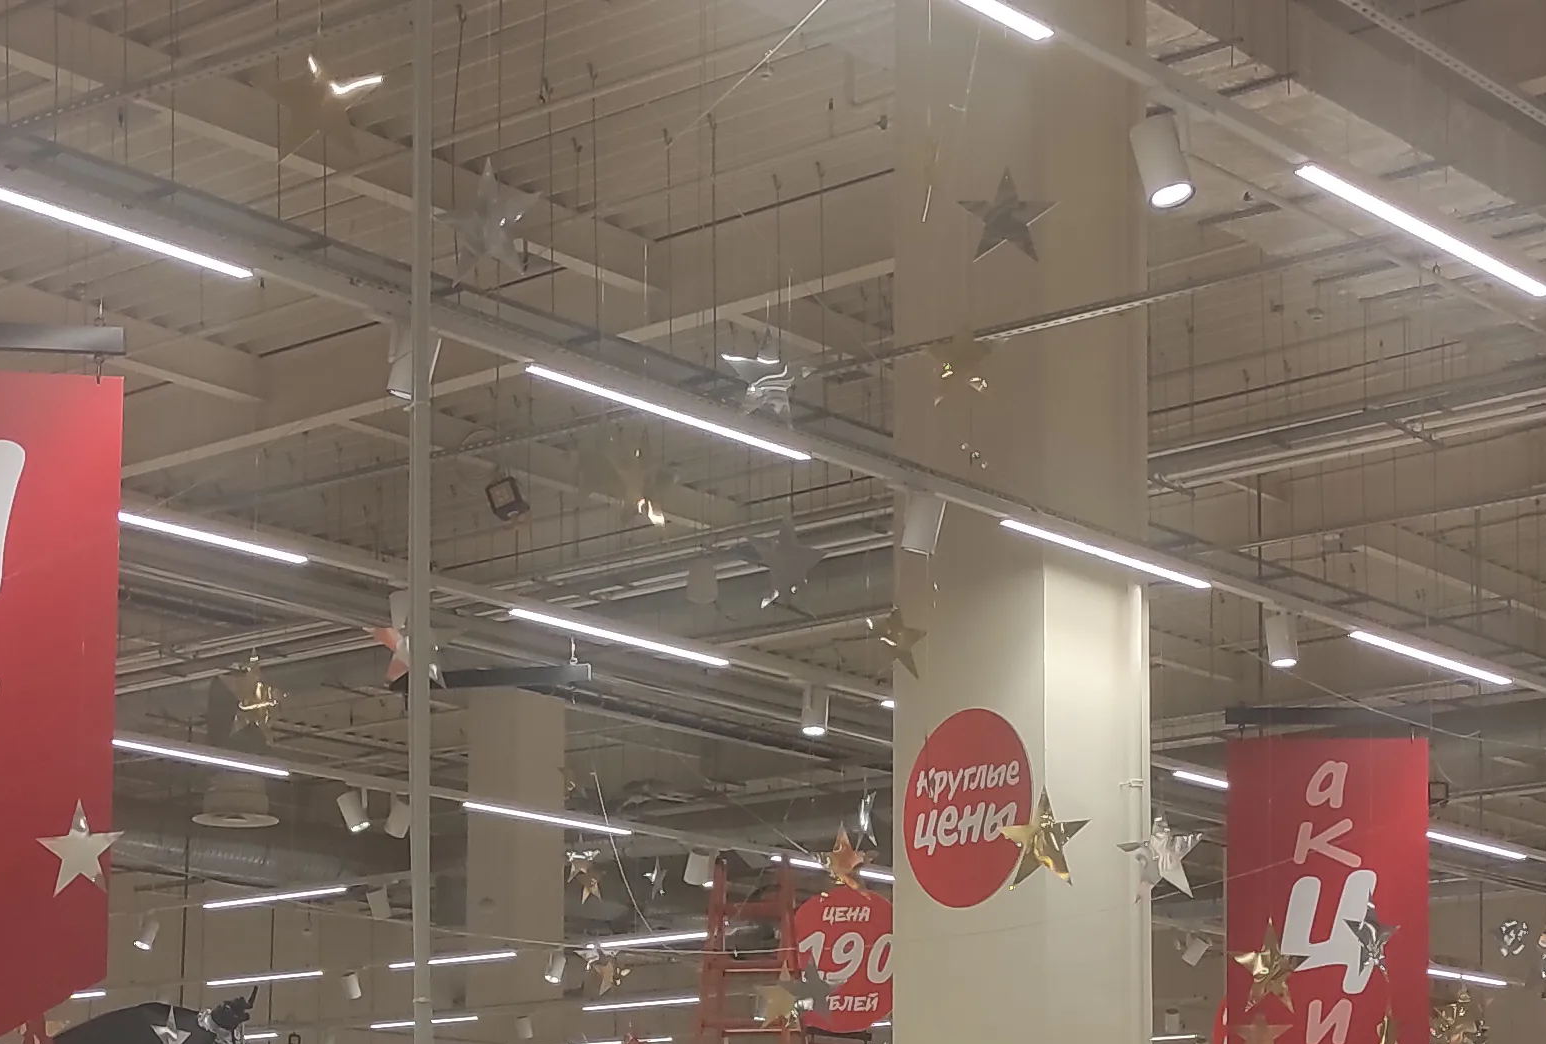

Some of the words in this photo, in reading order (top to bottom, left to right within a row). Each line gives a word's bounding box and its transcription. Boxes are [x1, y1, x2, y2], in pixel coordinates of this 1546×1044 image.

[913, 800, 1020, 856] цены
[822, 906, 871, 926] ЦЕНА
[799, 931, 893, 984] 190
[825, 992, 879, 1012] БЛЕЙ
